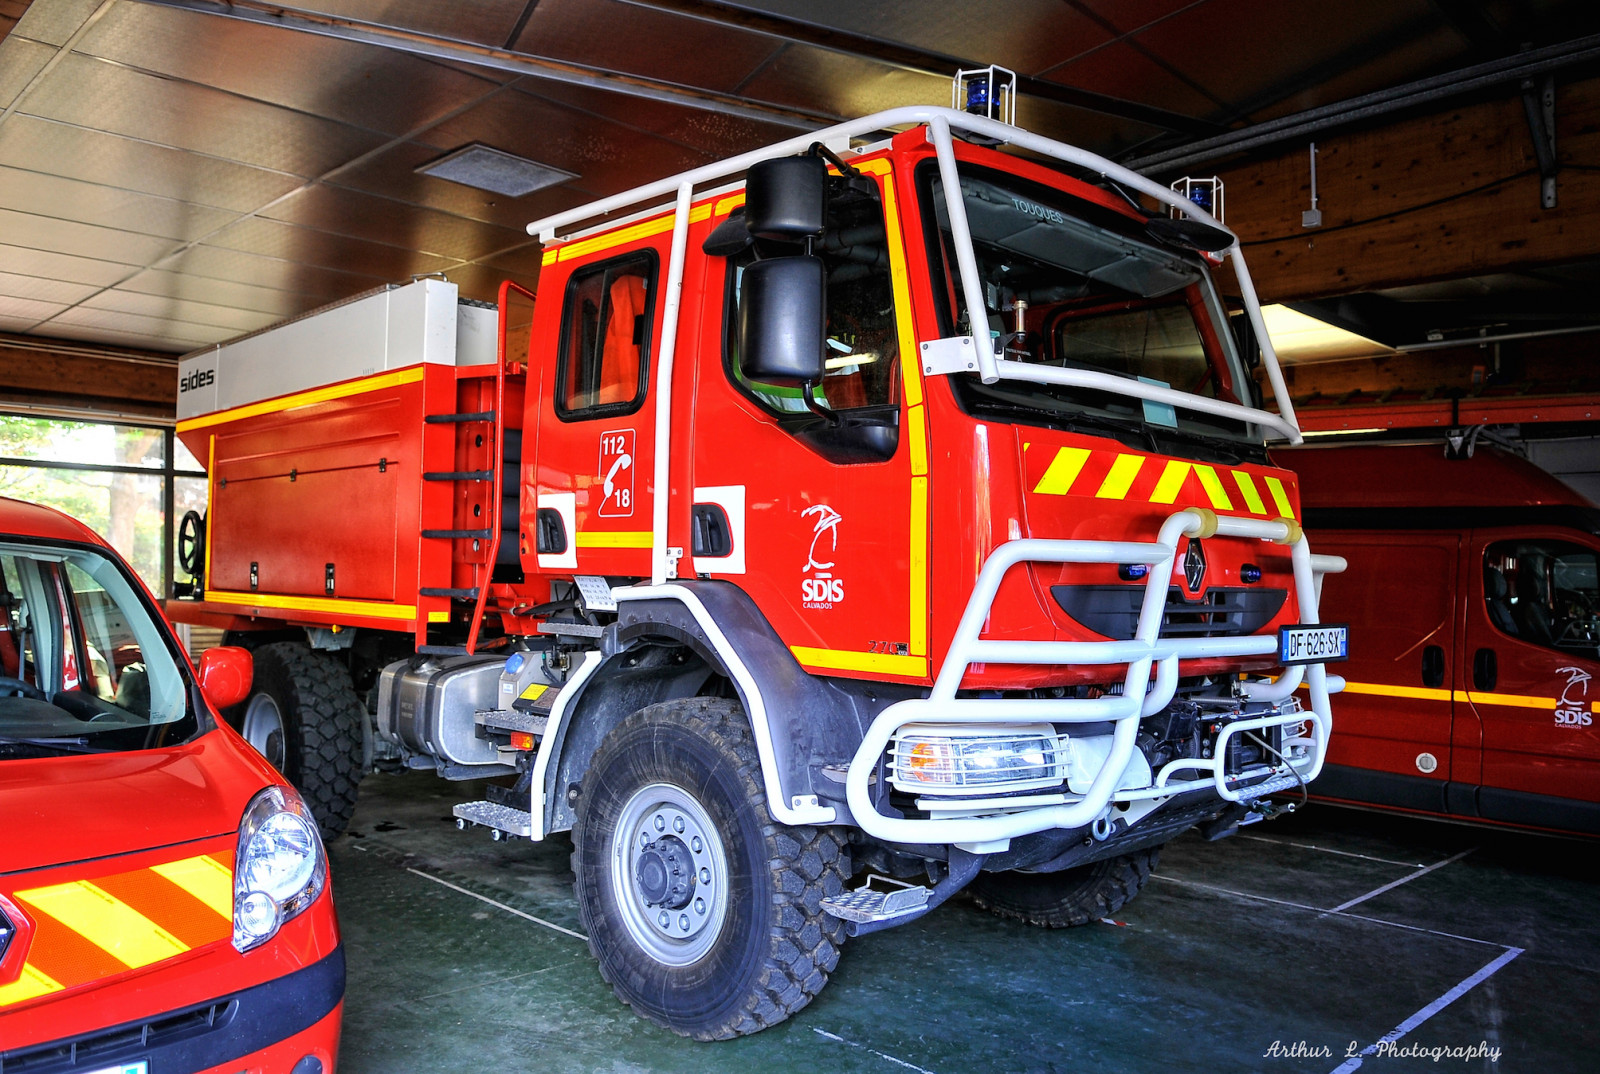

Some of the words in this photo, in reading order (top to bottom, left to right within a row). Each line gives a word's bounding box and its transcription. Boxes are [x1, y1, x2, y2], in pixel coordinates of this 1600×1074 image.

[1011, 198, 1064, 224] TOUQUES
[180, 369, 215, 393] sides
[603, 435, 625, 456] 112
[614, 488, 631, 508] 18
[801, 578, 845, 603] SDIS
[802, 602, 833, 610] CALVADOS
[1554, 709, 1593, 726] SDIS
